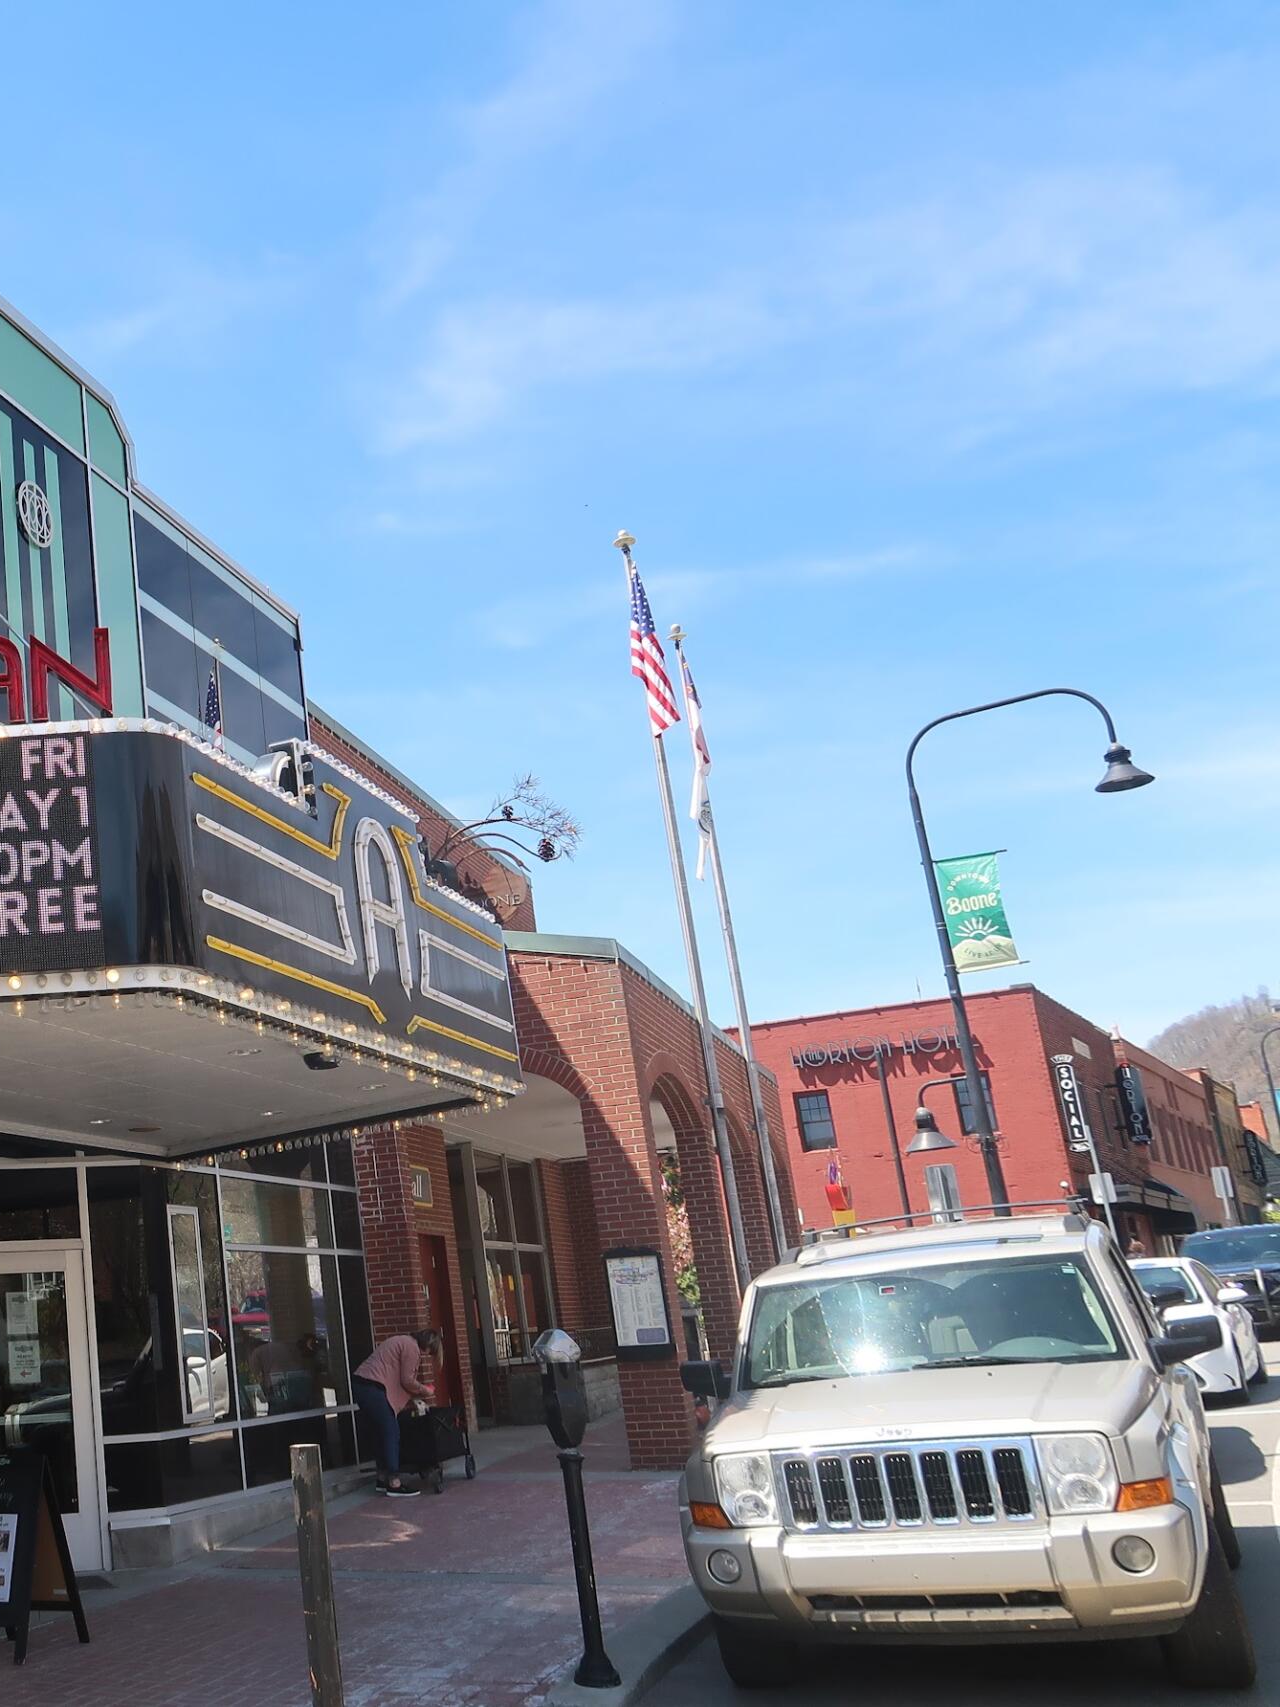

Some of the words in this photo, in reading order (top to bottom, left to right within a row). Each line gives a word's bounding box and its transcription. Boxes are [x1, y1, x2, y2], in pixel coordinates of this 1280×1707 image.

[20, 737, 86, 781] FRI
[71, 786, 90, 828] 1
[482, 892, 521, 909] ONE
[946, 872, 991, 892] DOWNTOWN
[945, 892, 998, 916] Boone
[788, 1033, 893, 1069] HORTON
[899, 1024, 980, 1056] HOTE
[1058, 1067, 1083, 1139] SOCIAL
